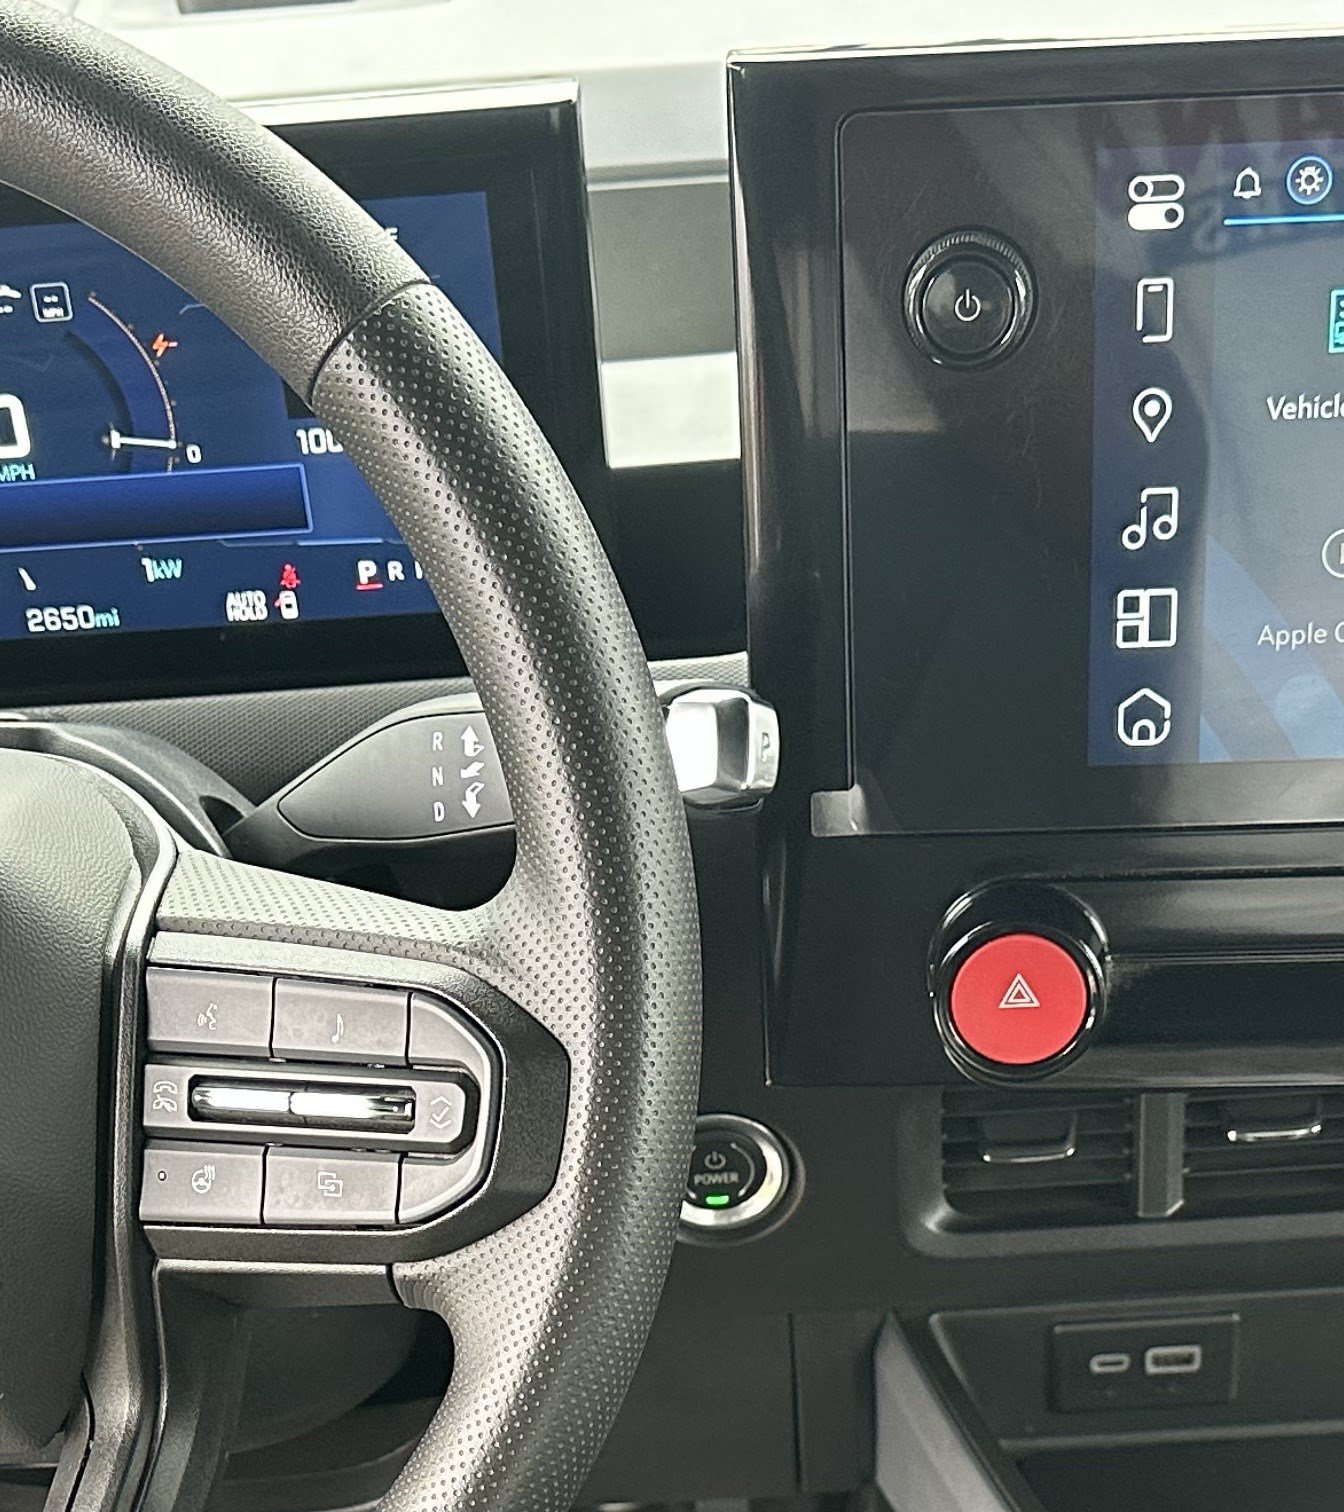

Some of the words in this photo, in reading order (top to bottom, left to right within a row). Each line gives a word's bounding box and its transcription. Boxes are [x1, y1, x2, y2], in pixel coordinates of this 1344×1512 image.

[187, 445, 203, 465] 0
[142, 558, 183, 584] 1kW
[356, 558, 378, 586] P
[386, 559, 406, 583] R
[226, 589, 268, 605] AUTO
[26, 605, 121, 633] 2650mi
[1257, 621, 1328, 651] Apple
[431, 730, 445, 752] R
[759, 730, 771, 764] P
[430, 765, 445, 788] N
[432, 800, 446, 823] D
[693, 1171, 739, 1185] POWER
